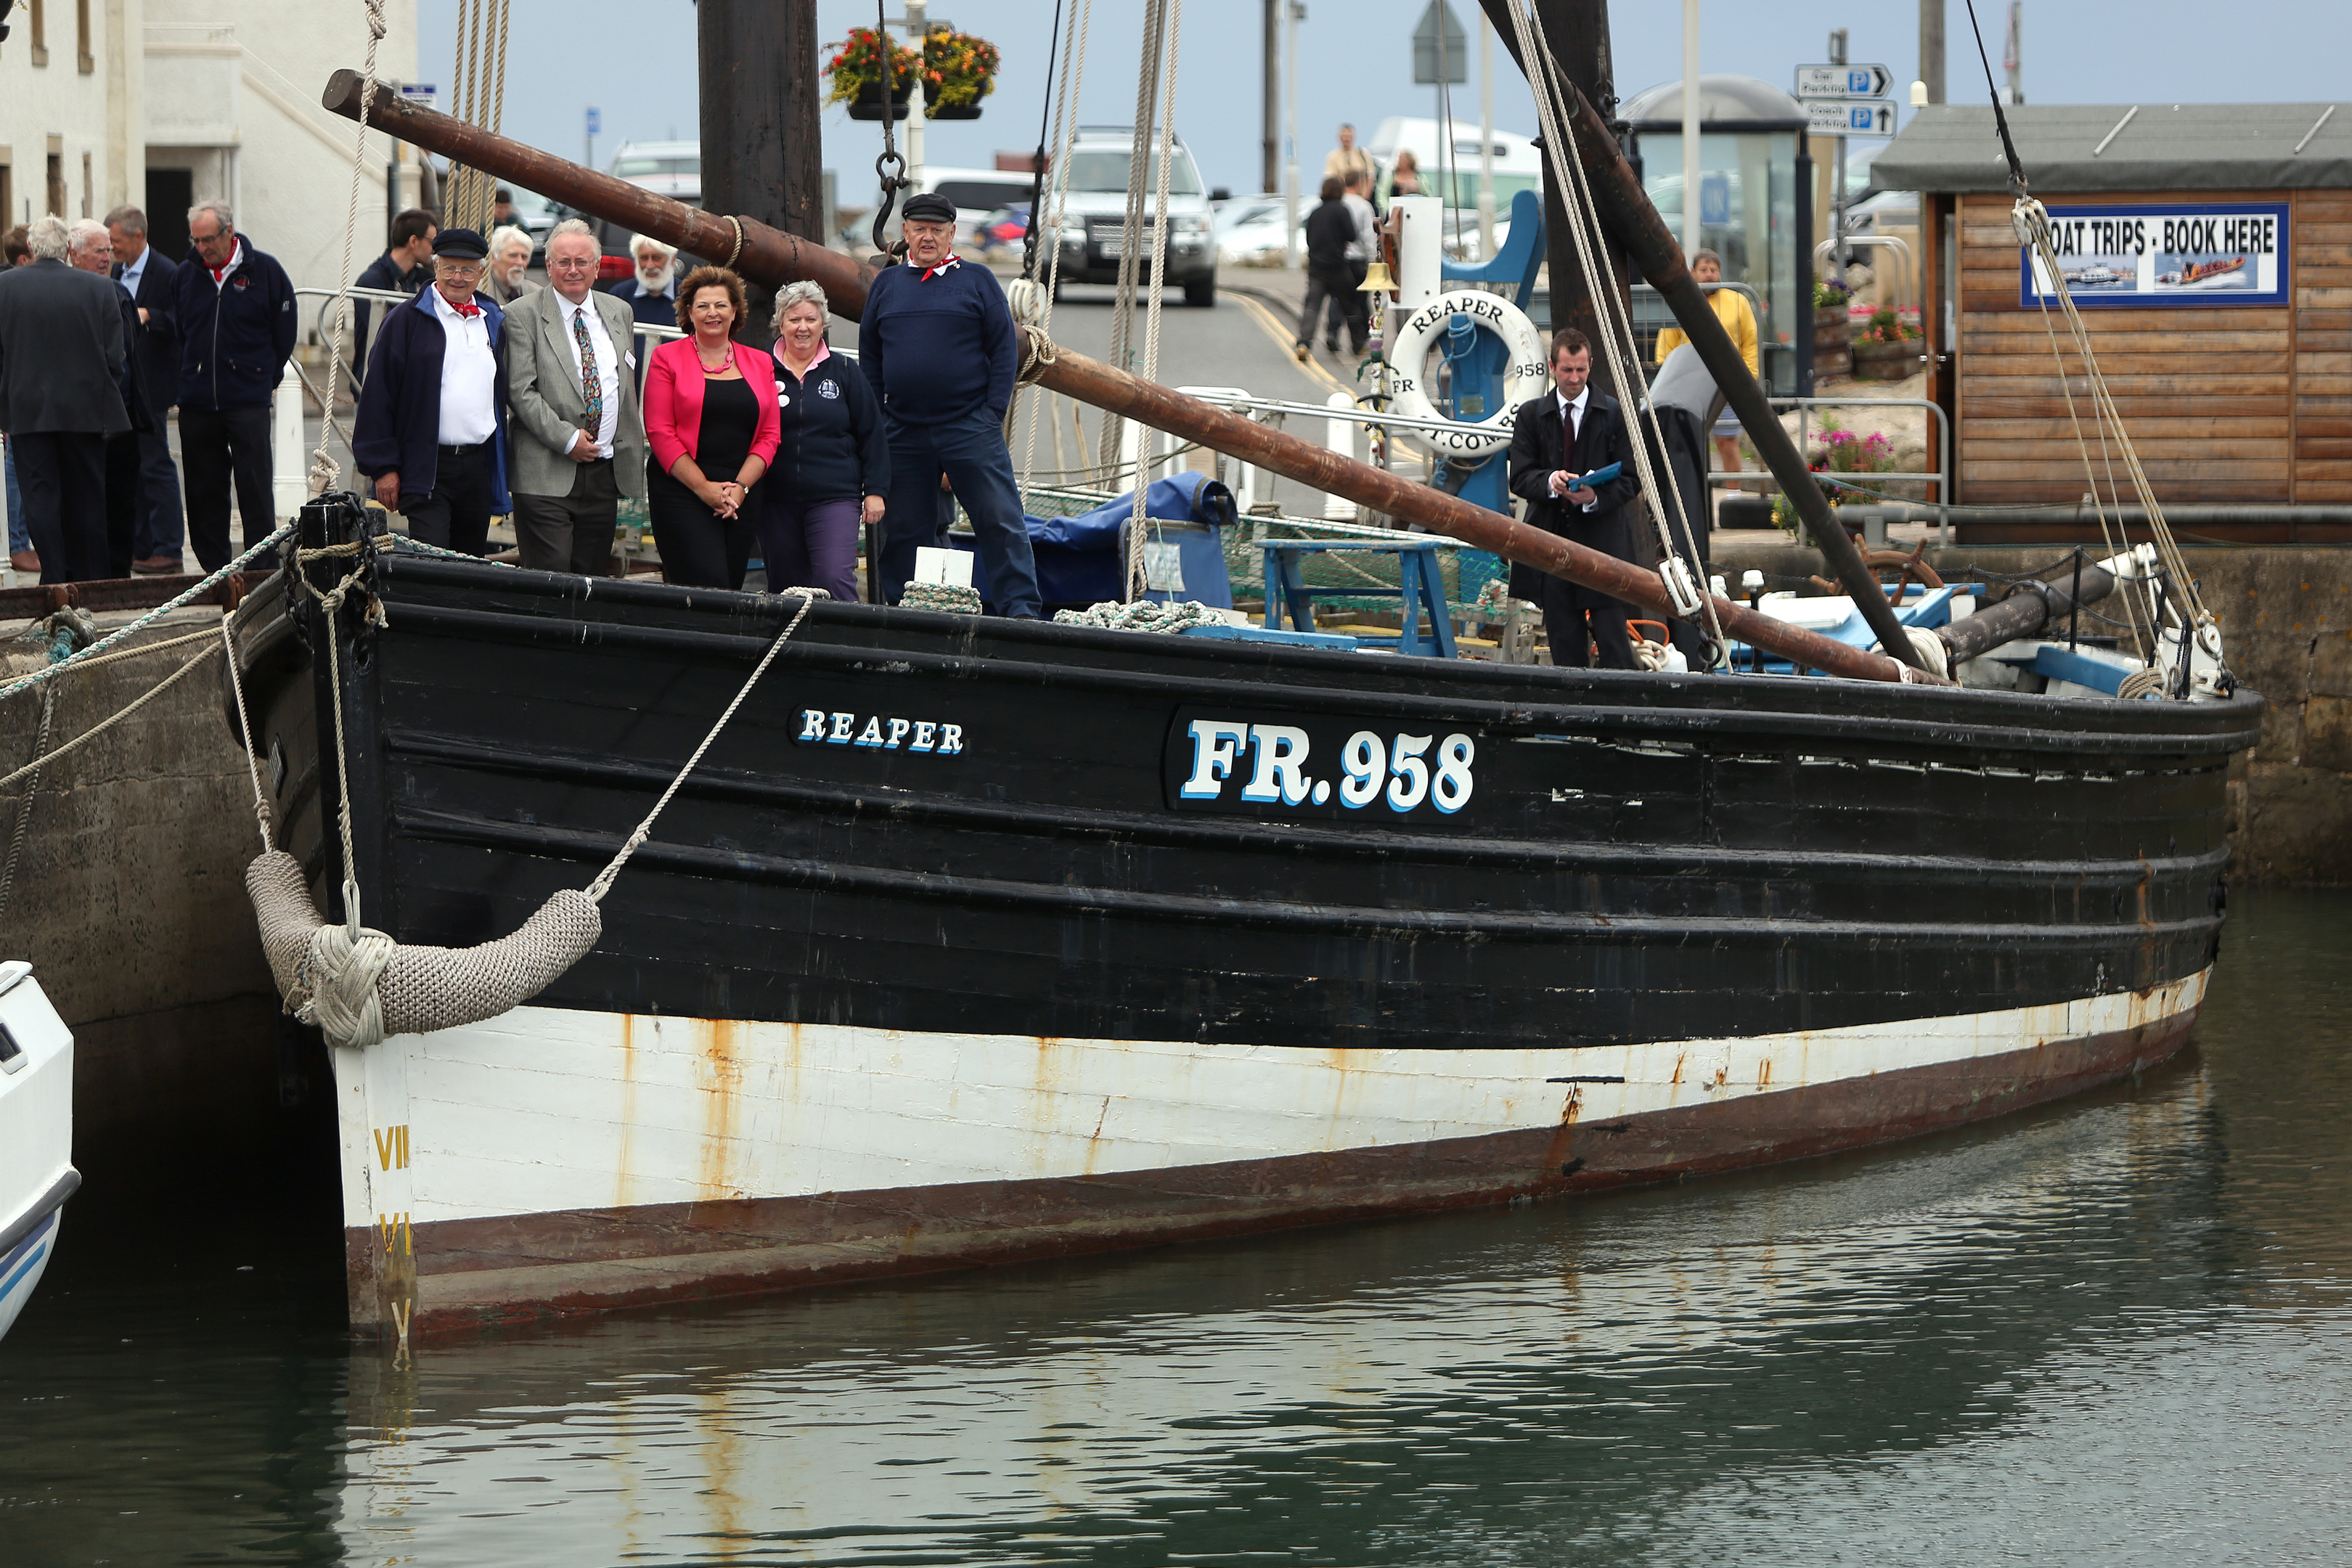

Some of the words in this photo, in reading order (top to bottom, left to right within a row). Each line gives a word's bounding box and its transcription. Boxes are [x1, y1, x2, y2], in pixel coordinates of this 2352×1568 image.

[1801, 82, 1847, 96] Parking
[1812, 69, 1833, 81] Car
[1808, 103, 1845, 117] Coach
[1808, 118, 1849, 131] arking
[2037, 219, 2085, 256] OAT
[2091, 219, 2145, 256] TRIPS
[2164, 219, 2217, 255] BOOK
[2224, 219, 2274, 254] HERE
[1412, 297, 1504, 335] REAPER
[1392, 379, 1416, 393] FR
[1516, 362, 1545, 378] 958
[799, 709, 963, 755] REAPER
[1180, 719, 1475, 814] FR.958
[374, 1124, 409, 1171] VII
[380, 1212, 412, 1256] VI
[391, 1298, 412, 1339] V
